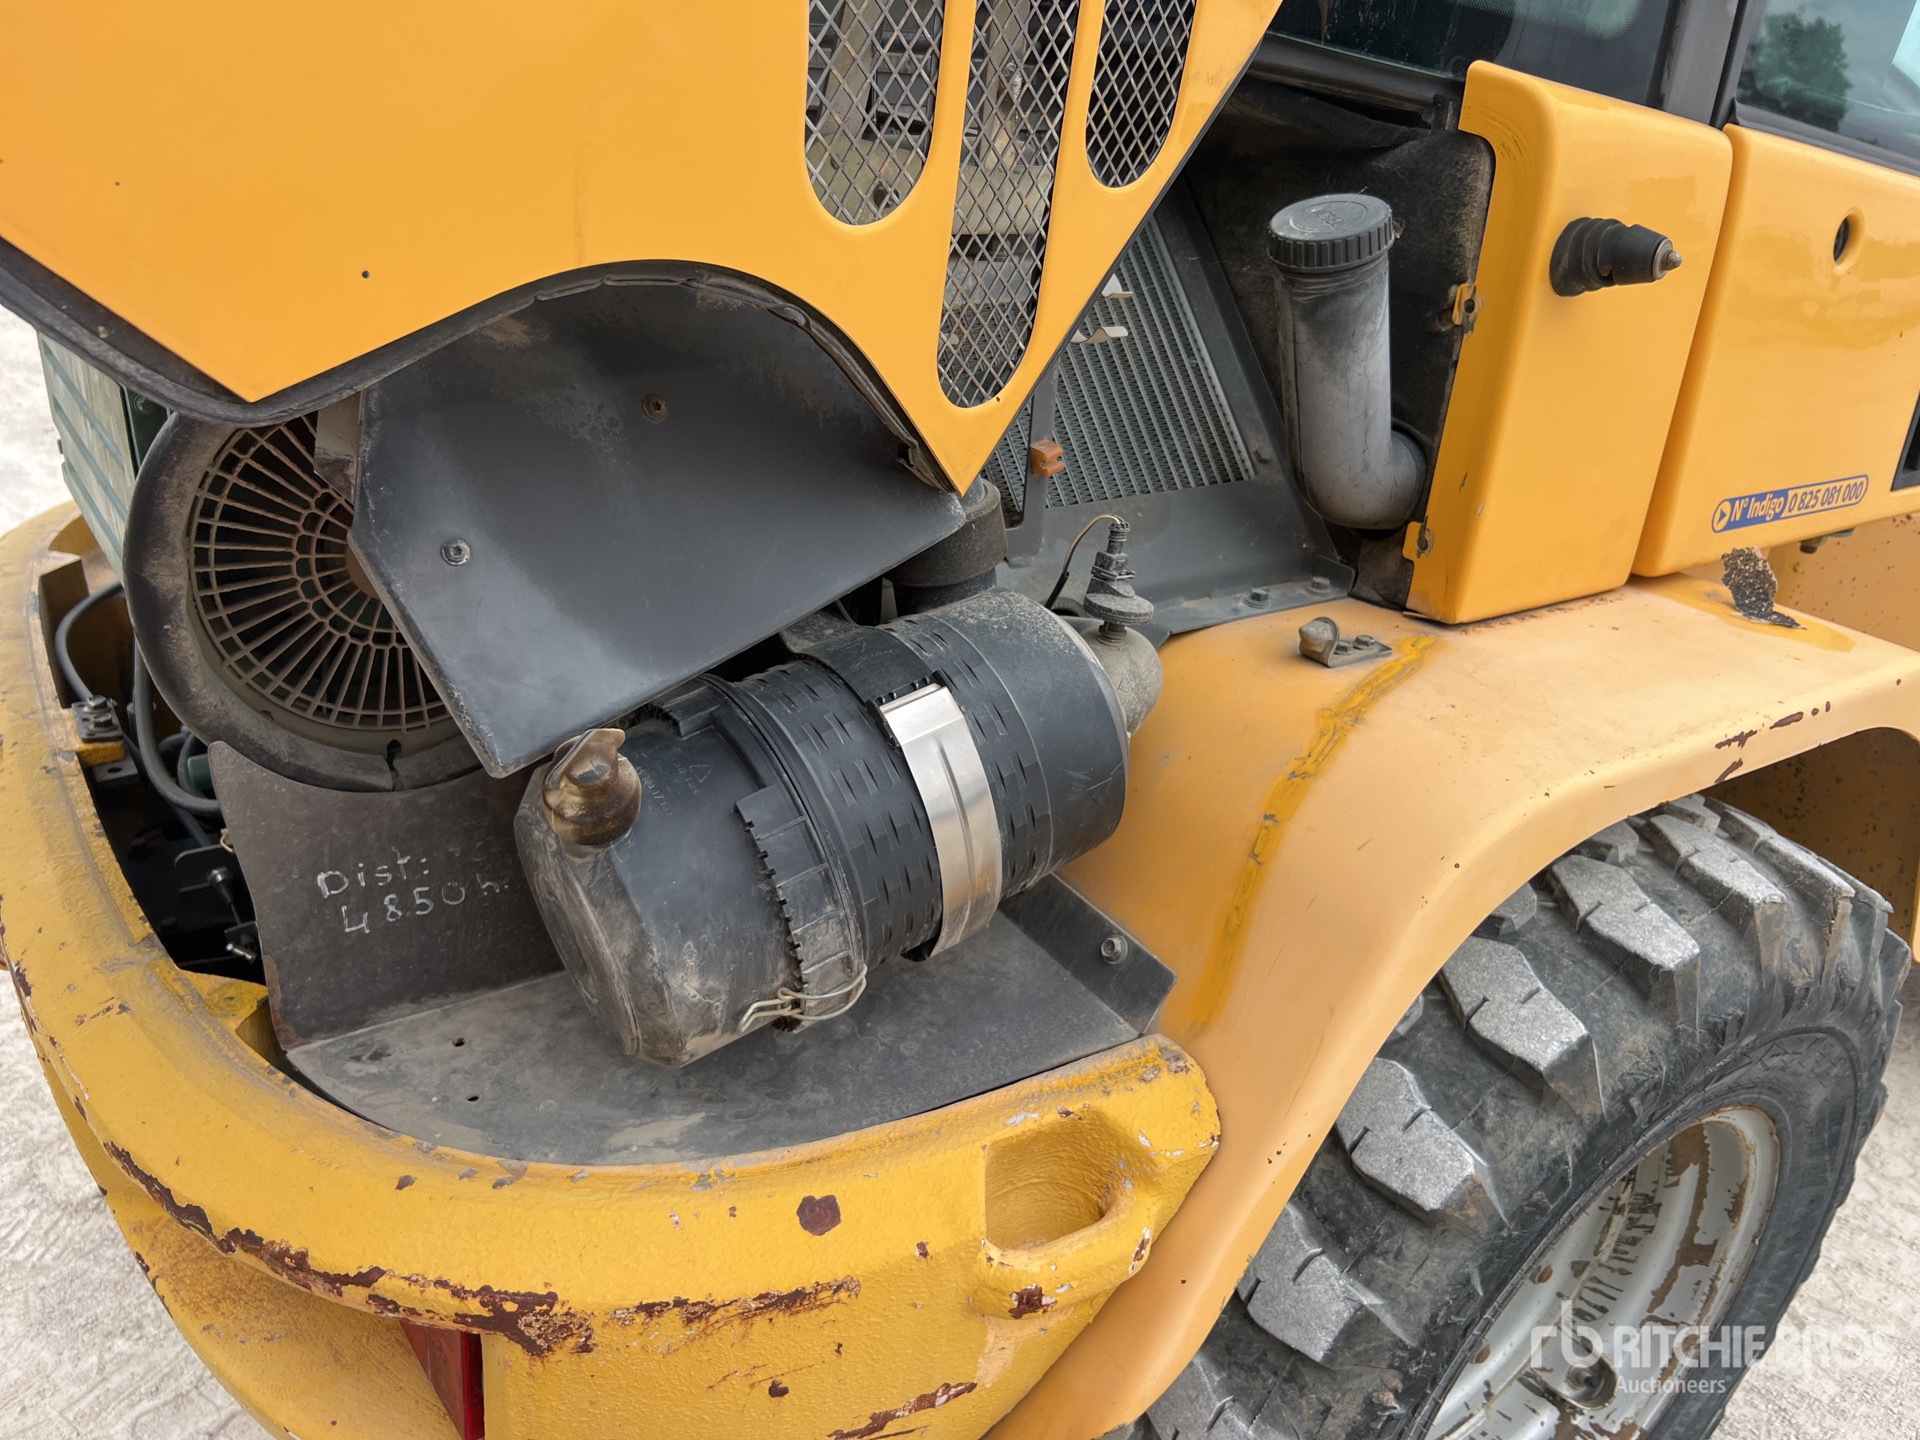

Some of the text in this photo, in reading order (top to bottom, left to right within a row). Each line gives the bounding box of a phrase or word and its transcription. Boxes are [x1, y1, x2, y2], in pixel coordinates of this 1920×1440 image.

[1747, 493, 1785, 521] Indigo
[1788, 493, 1798, 513] 0
[1797, 489, 1822, 511] 825
[1820, 484, 1843, 507] 081
[1842, 481, 1864, 502] 000
